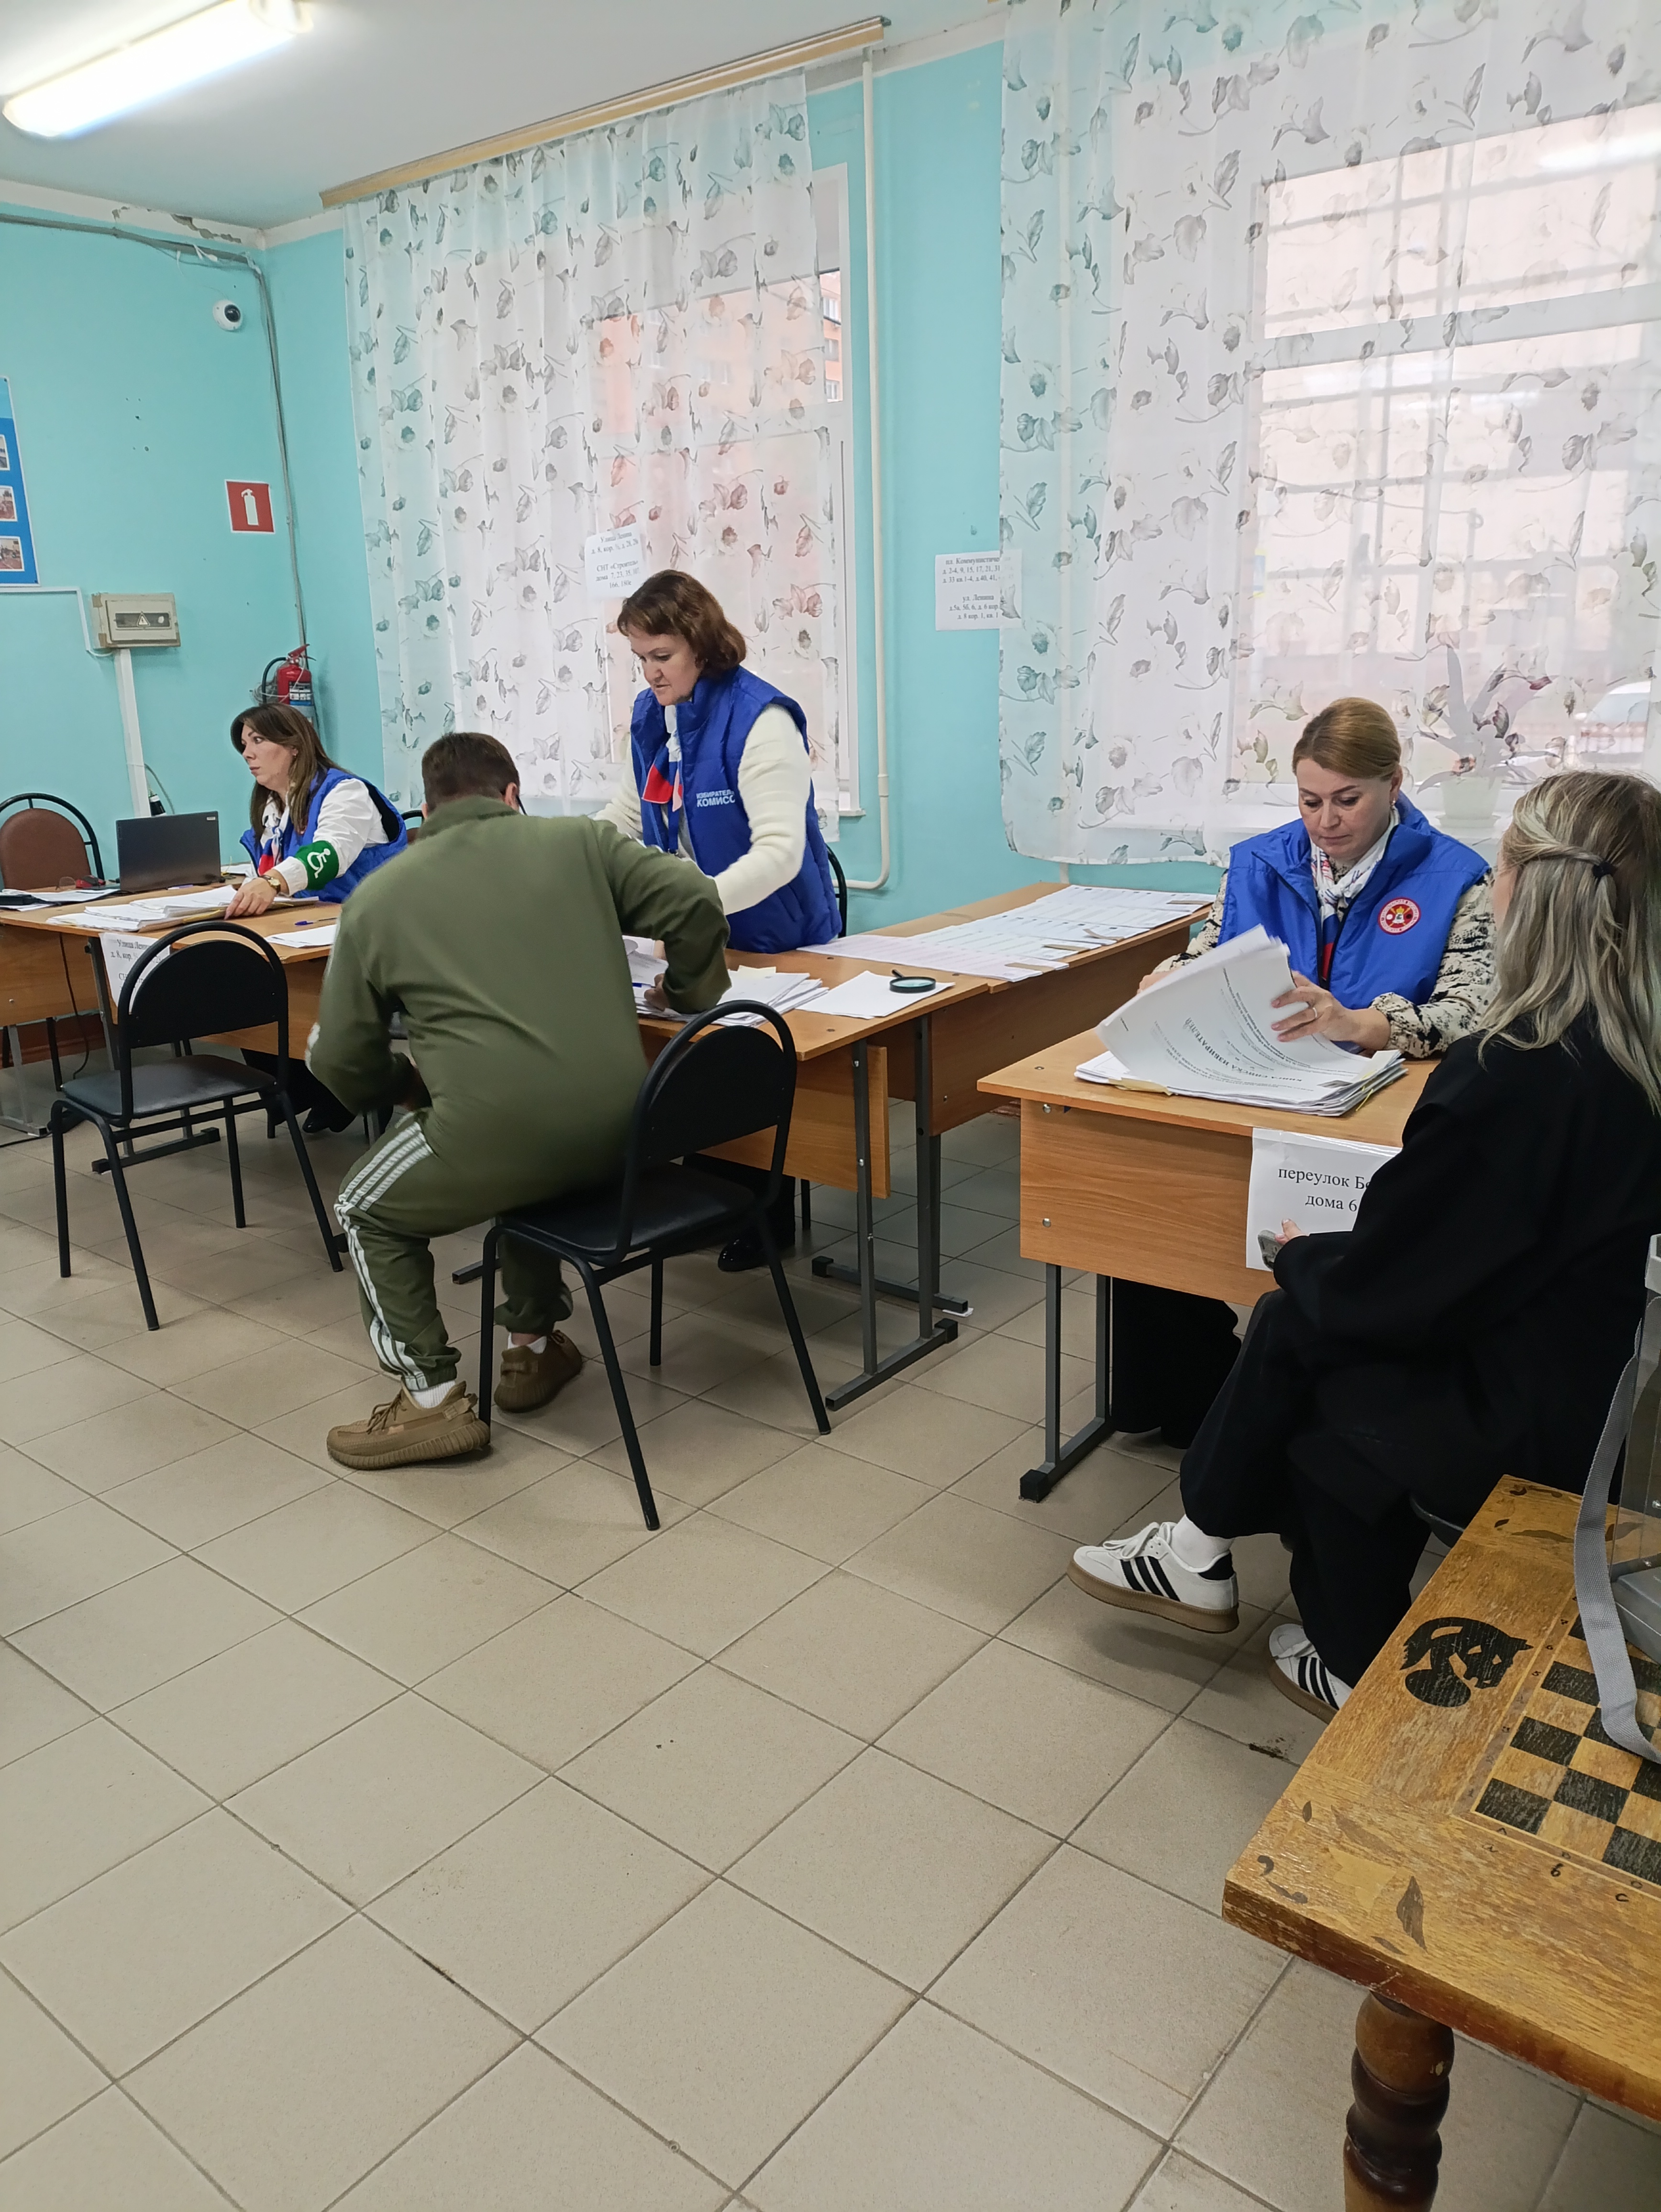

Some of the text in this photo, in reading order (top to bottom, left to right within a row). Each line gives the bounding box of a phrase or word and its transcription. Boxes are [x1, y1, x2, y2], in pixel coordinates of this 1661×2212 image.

[597, 564, 609, 572] СНТ
[1184, 1017, 1229, 1066] ИЗБИРАТЕЛЕЙ
[1278, 1168, 1350, 1188] переулок
[1305, 1195, 1357, 1212] дома 6
